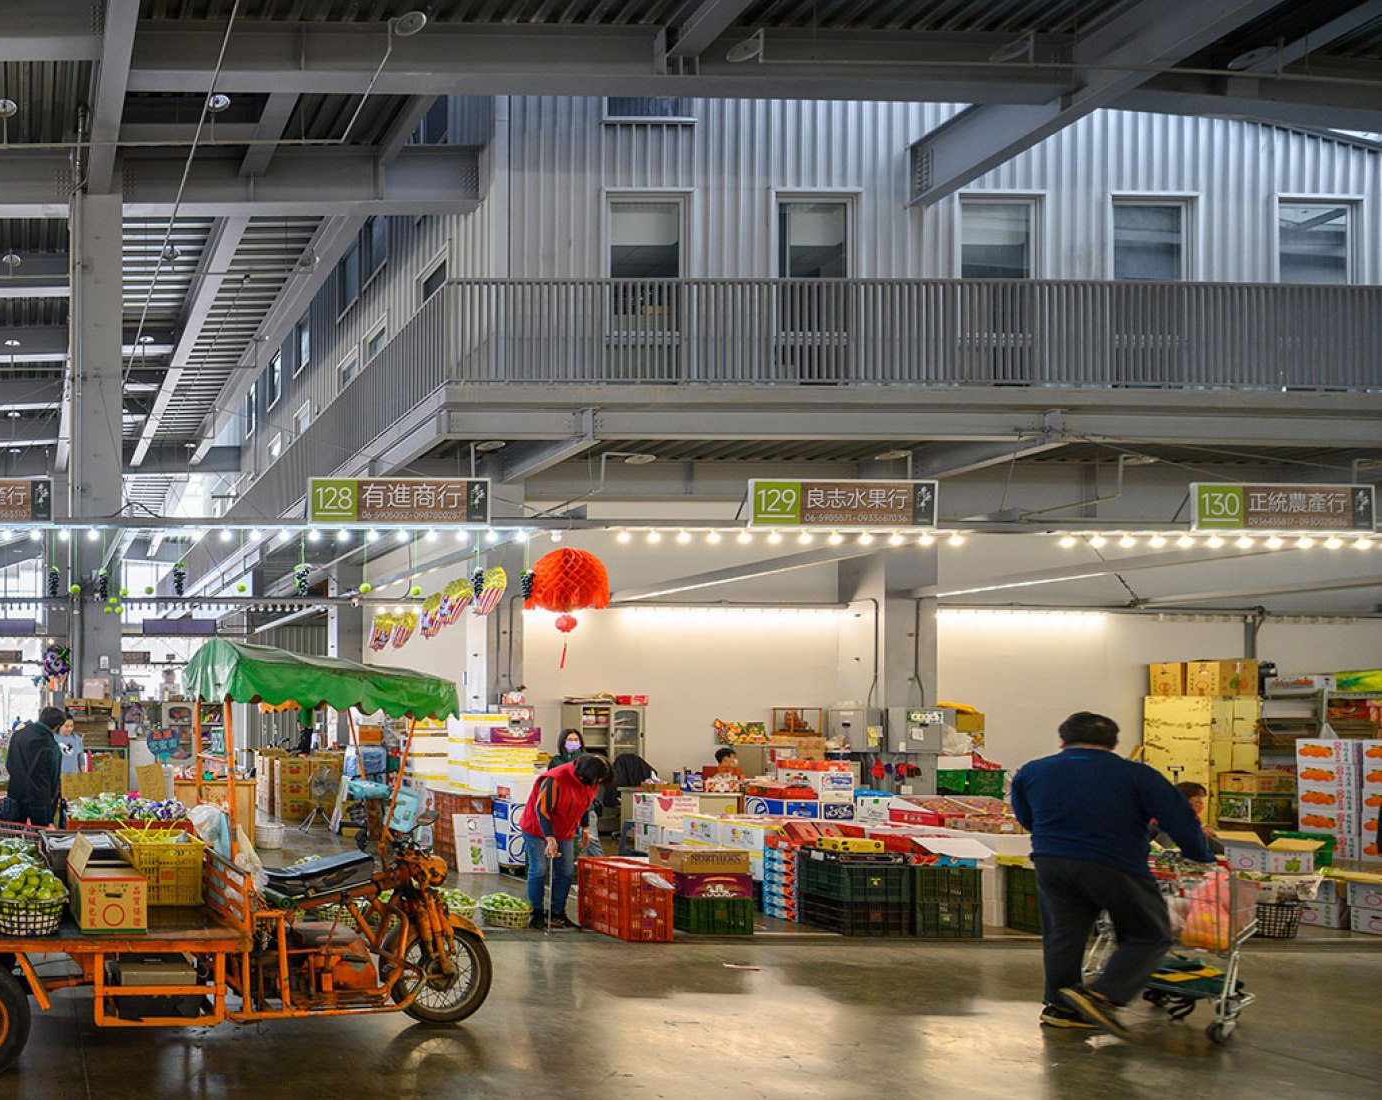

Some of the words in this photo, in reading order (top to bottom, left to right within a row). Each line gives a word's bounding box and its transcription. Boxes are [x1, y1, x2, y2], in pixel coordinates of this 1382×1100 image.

[315, 486, 353, 510] 128
[361, 483, 462, 509] 有進商行
[756, 488, 797, 512] 129
[806, 487, 909, 510] 良志水果行
[1201, 493, 1240, 516] 130
[1248, 492, 1347, 513] 正統農產行
